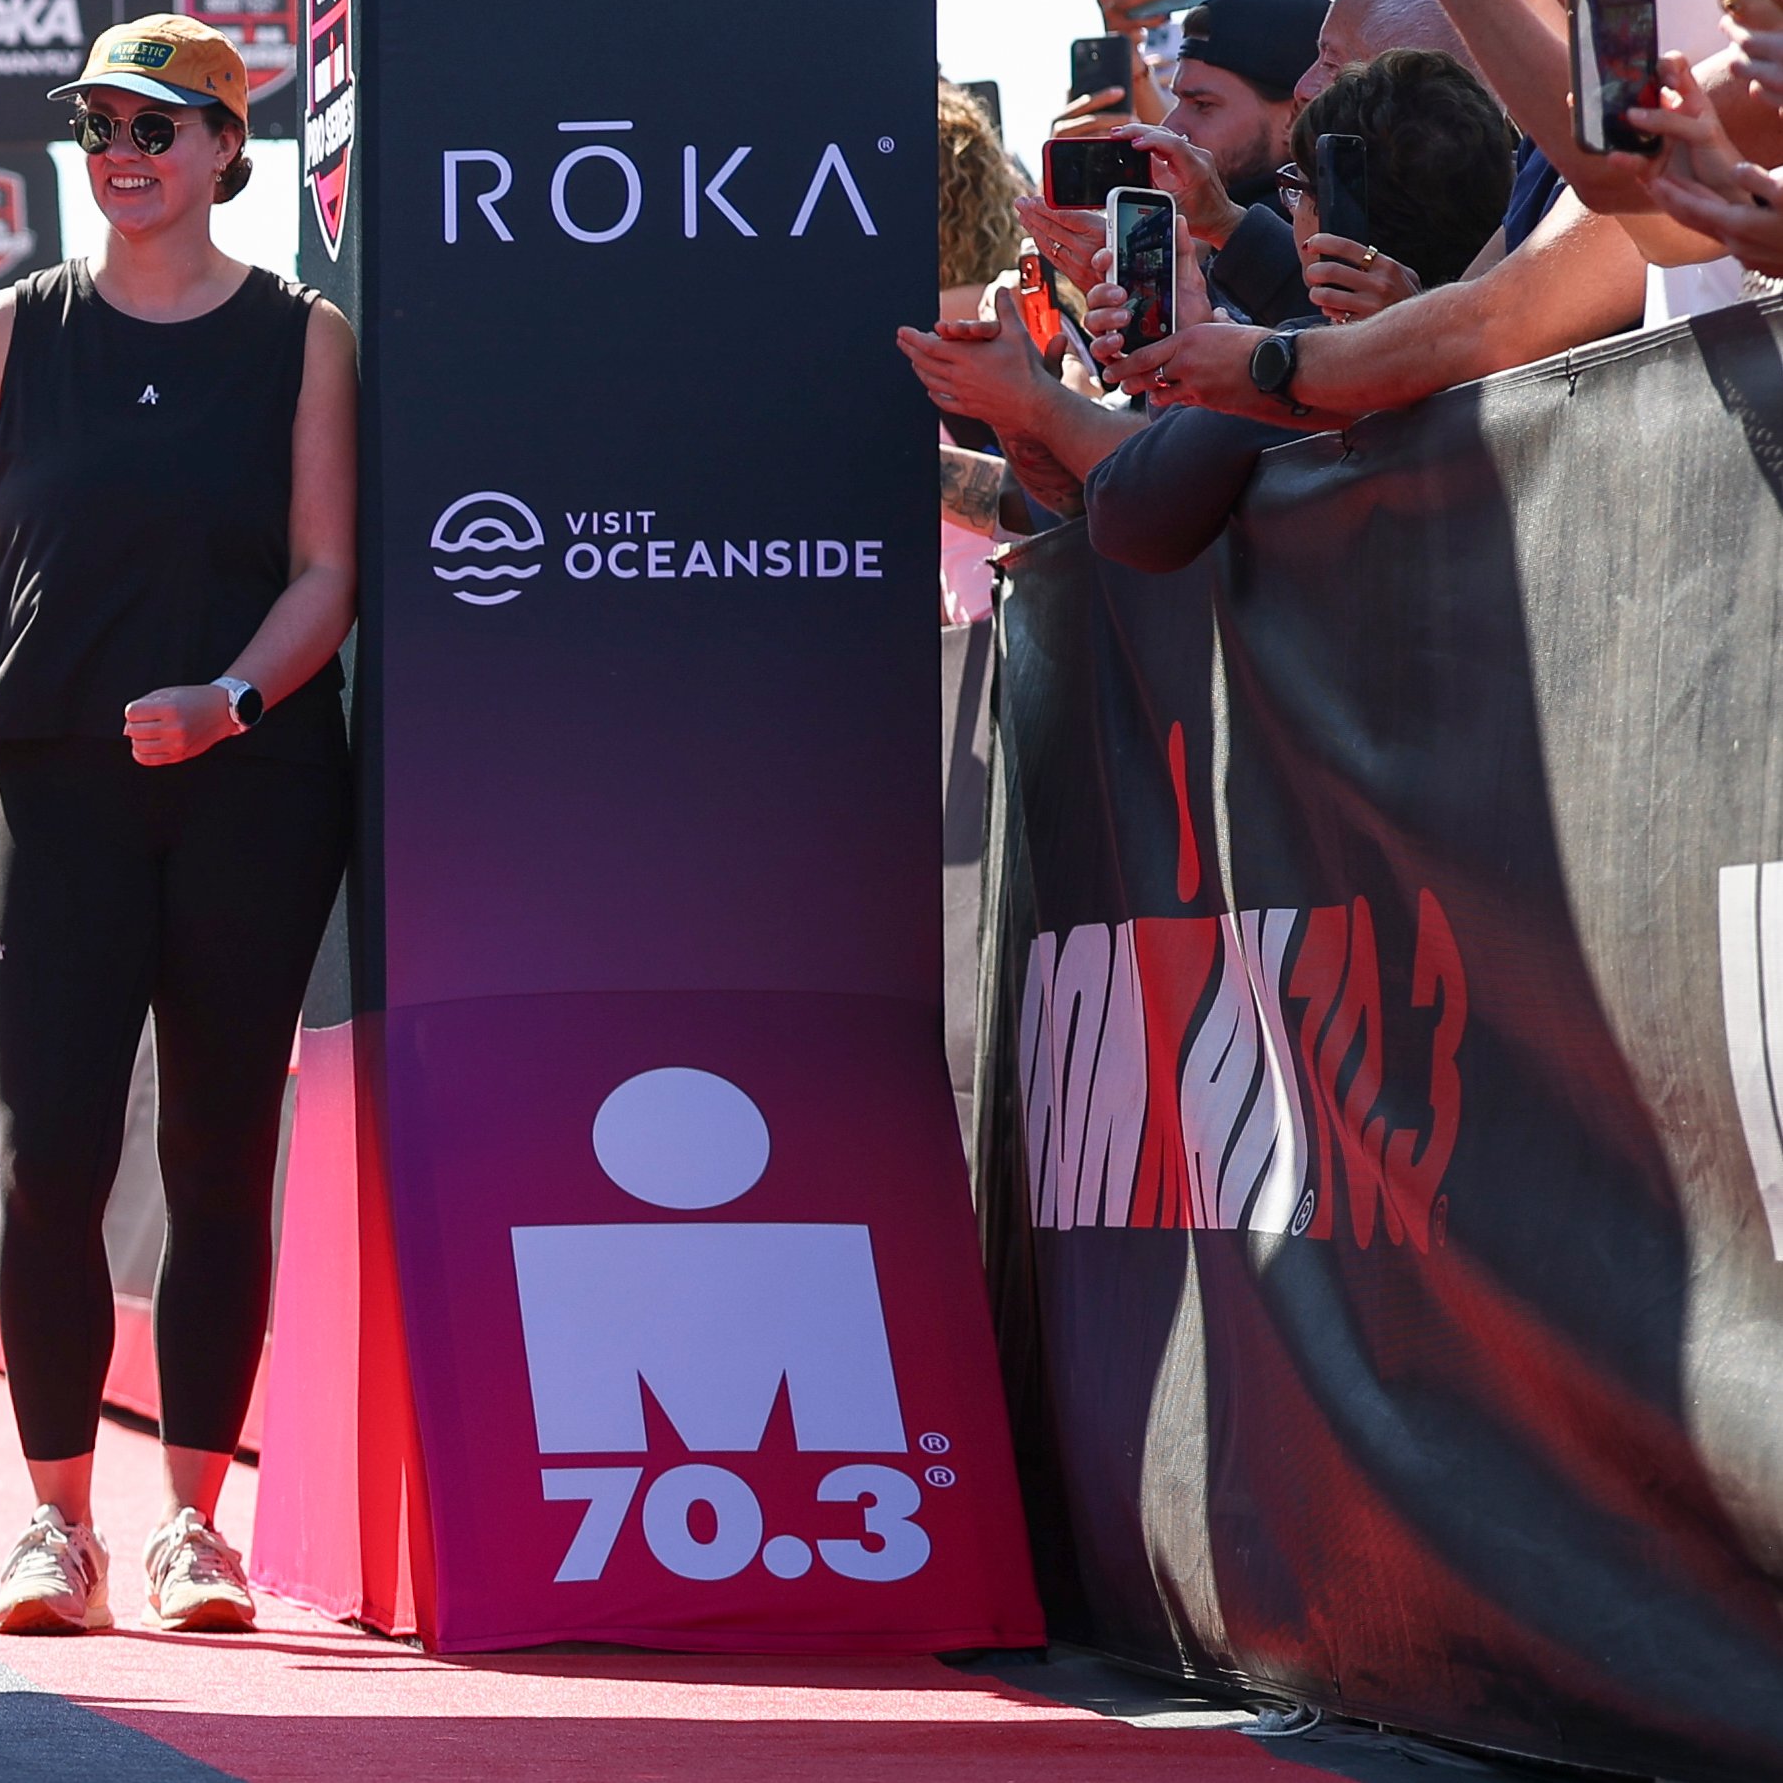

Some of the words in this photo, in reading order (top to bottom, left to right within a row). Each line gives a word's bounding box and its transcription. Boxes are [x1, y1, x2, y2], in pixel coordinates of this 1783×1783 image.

[114, 43, 166, 57] ATHLETIC
[565, 510, 656, 535] VISIT
[564, 540, 883, 580] OCEANSIDE
[1289, 888, 1467, 1255] 70.3
[540, 1463, 931, 1583] 70.3
